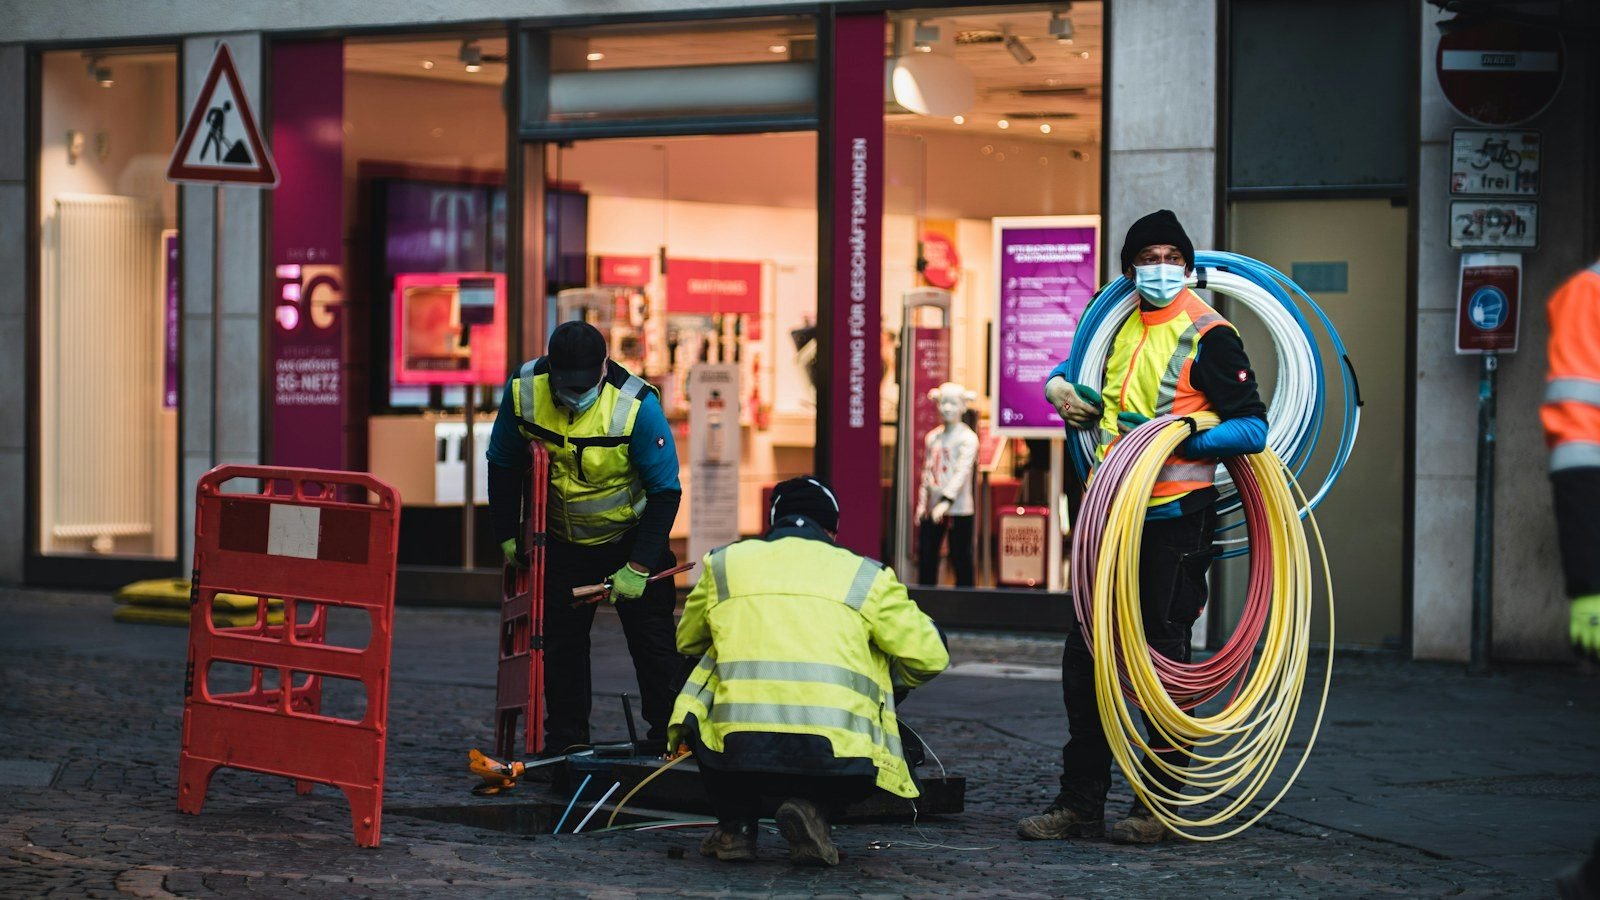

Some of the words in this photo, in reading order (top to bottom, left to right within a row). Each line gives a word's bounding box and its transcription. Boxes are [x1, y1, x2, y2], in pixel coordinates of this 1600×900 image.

[1481, 174, 1510, 189] frei
[849, 137, 867, 301] GESCHÄFTSKUNDEN
[275, 264, 341, 332] 5G
[848, 303, 865, 337] FÜR
[276, 359, 295, 372] DAS
[276, 373, 339, 391] 5G-NETZ
[849, 339, 865, 428] BERATUNG
